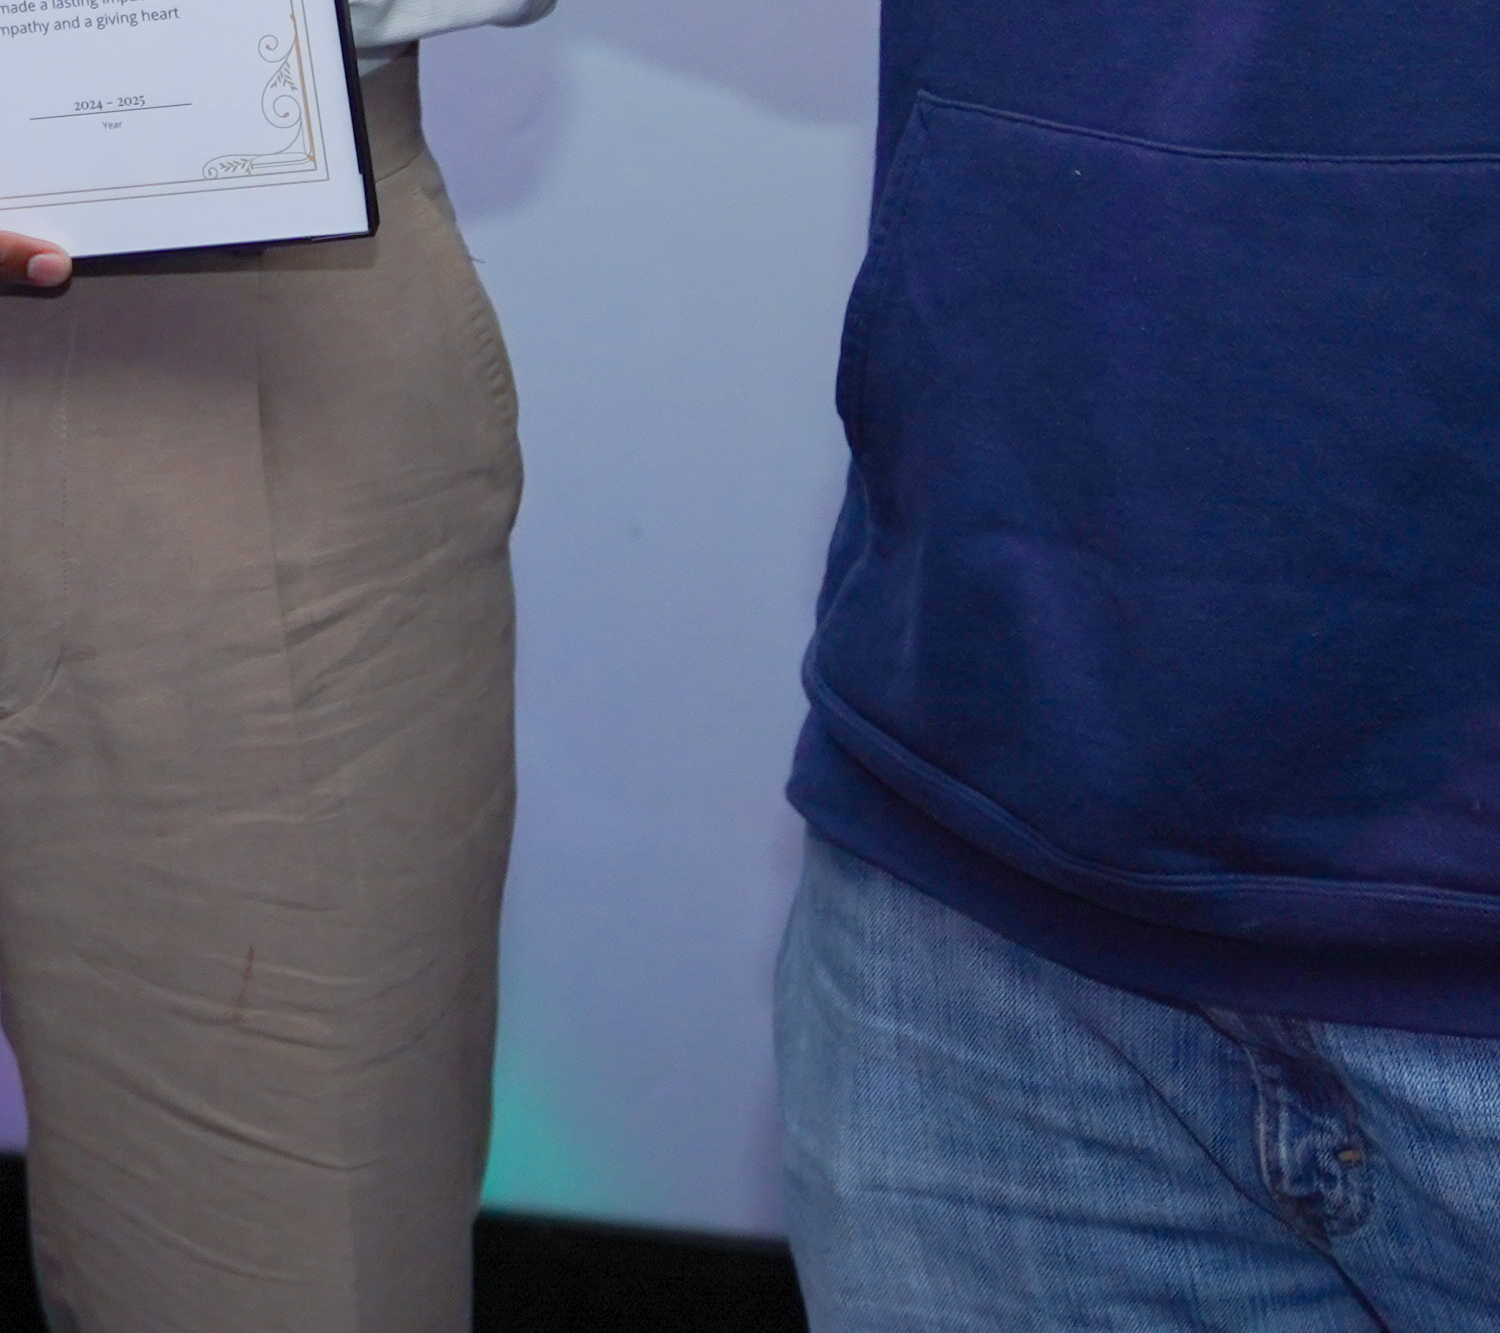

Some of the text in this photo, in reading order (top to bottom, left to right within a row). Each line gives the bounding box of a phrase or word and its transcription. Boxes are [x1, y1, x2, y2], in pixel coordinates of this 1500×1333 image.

[40, 0, 49, 12] a
[53, 16, 81, 32] and
[84, 17, 93, 29] a
[96, 11, 139, 31] giving
[141, 7, 181, 22] heart
[73, 99, 104, 112] 2024
[116, 95, 146, 108] 2025
[102, 120, 122, 130] Year
